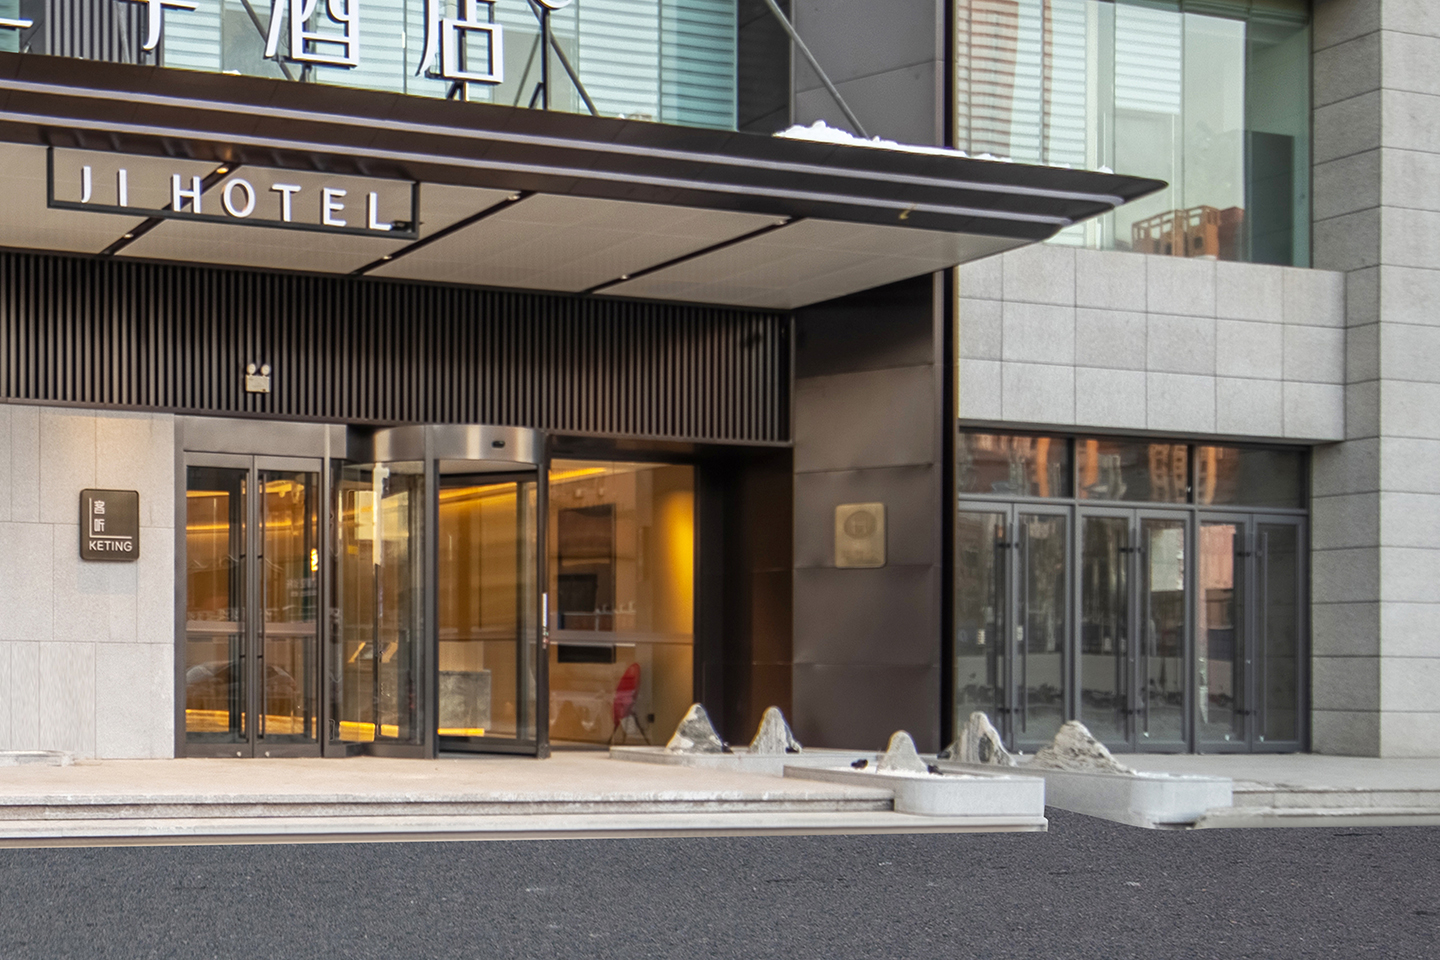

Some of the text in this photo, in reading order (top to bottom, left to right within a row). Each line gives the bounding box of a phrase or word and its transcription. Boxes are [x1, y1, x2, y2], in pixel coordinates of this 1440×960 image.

[80, 165, 393, 231] JI HOTEL
[89, 540, 133, 552] KETING
